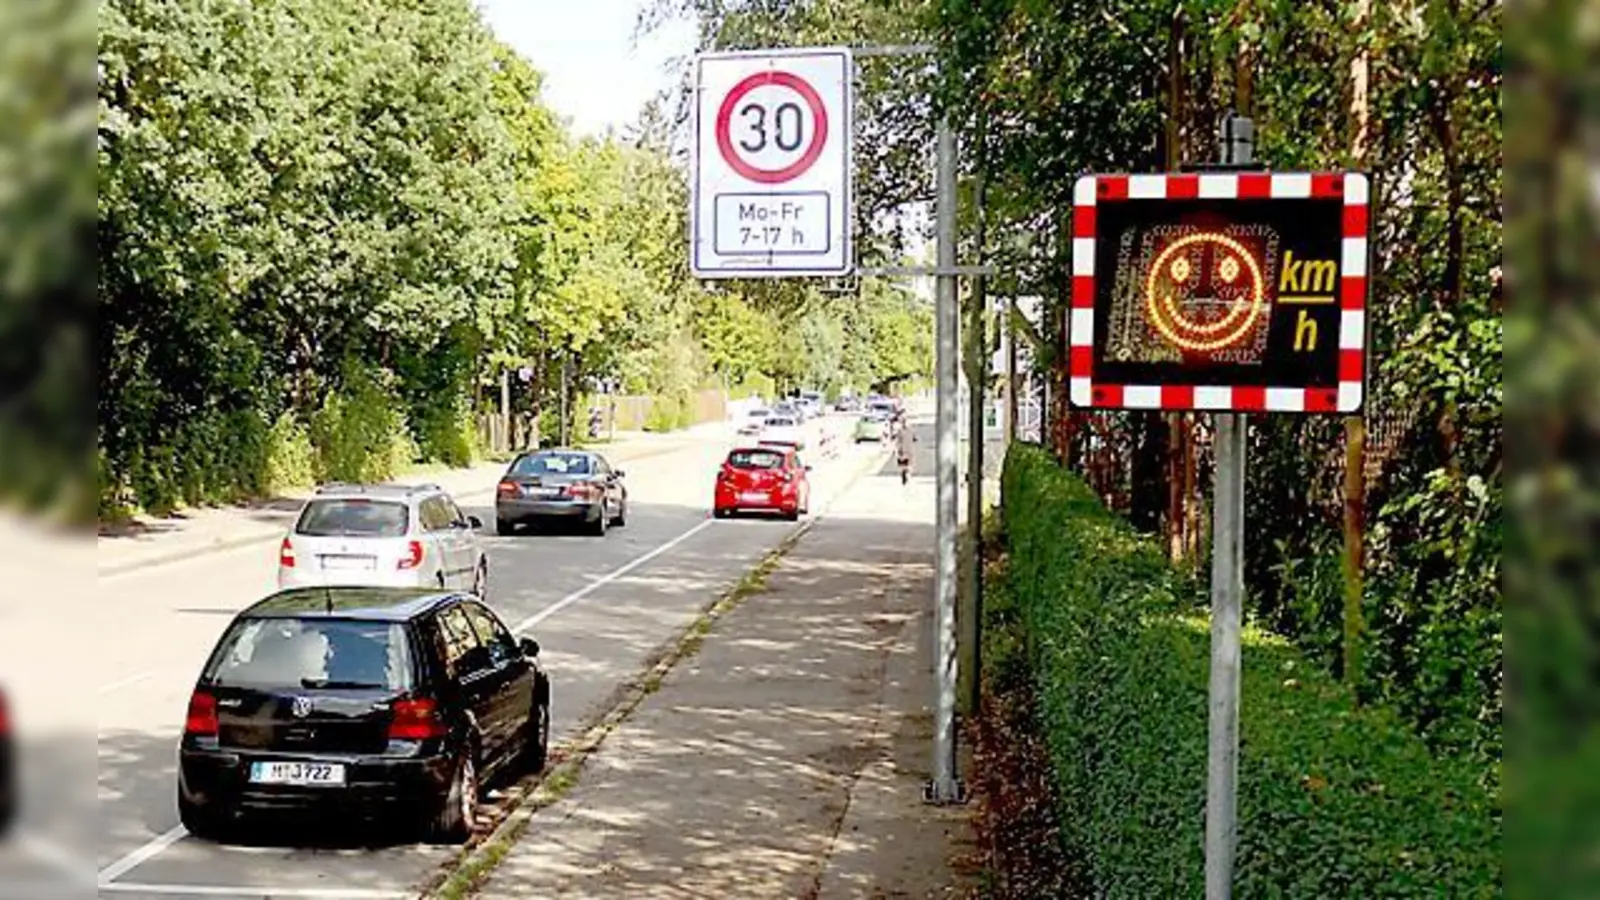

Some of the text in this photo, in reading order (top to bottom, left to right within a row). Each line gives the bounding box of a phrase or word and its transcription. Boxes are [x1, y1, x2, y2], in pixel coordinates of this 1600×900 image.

[739, 102, 804, 153] 30
[739, 203, 803, 220] Mo-Fr
[740, 226, 804, 245] 7-17 h
[1279, 250, 1337, 292] km
[1294, 310, 1318, 351] h
